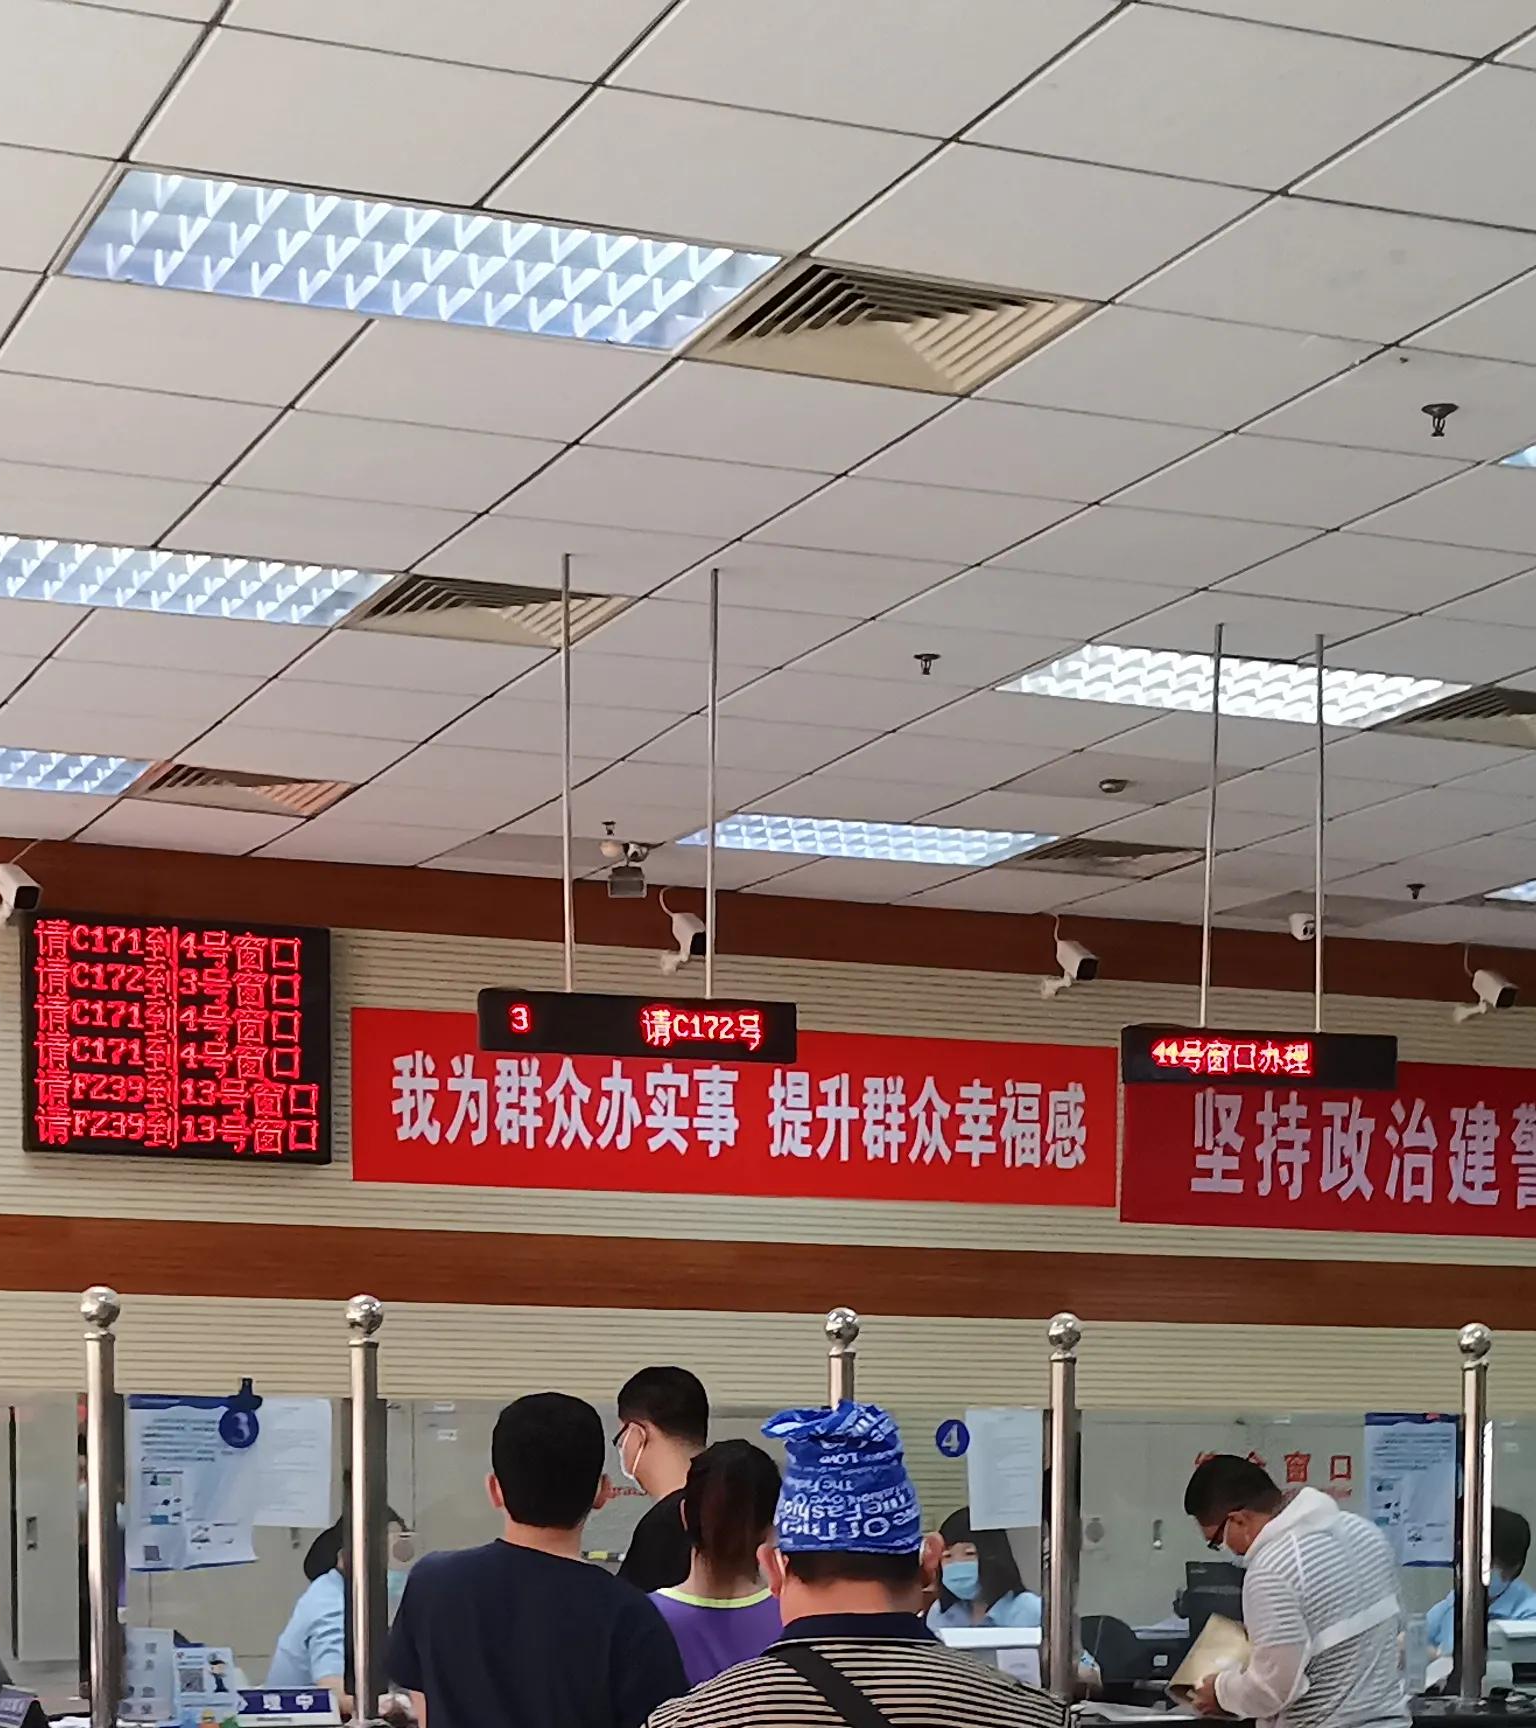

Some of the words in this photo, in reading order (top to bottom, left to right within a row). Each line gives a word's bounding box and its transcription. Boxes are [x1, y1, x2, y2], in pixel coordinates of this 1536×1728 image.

[34, 919, 302, 972] 请C171到4号窗口
[34, 956, 302, 1008] 请C172到3号窗口
[34, 994, 302, 1044] 请C171到4号窗口
[511, 1005, 529, 1033] 3
[641, 1009, 762, 1051] 请C172号
[34, 1032, 302, 1081] 请C171到4号窗口
[392, 1050, 740, 1157] 我为群众办实事
[767, 1068, 1087, 1169] 提升群众幸福感
[941, 1422, 961, 1453] 4
